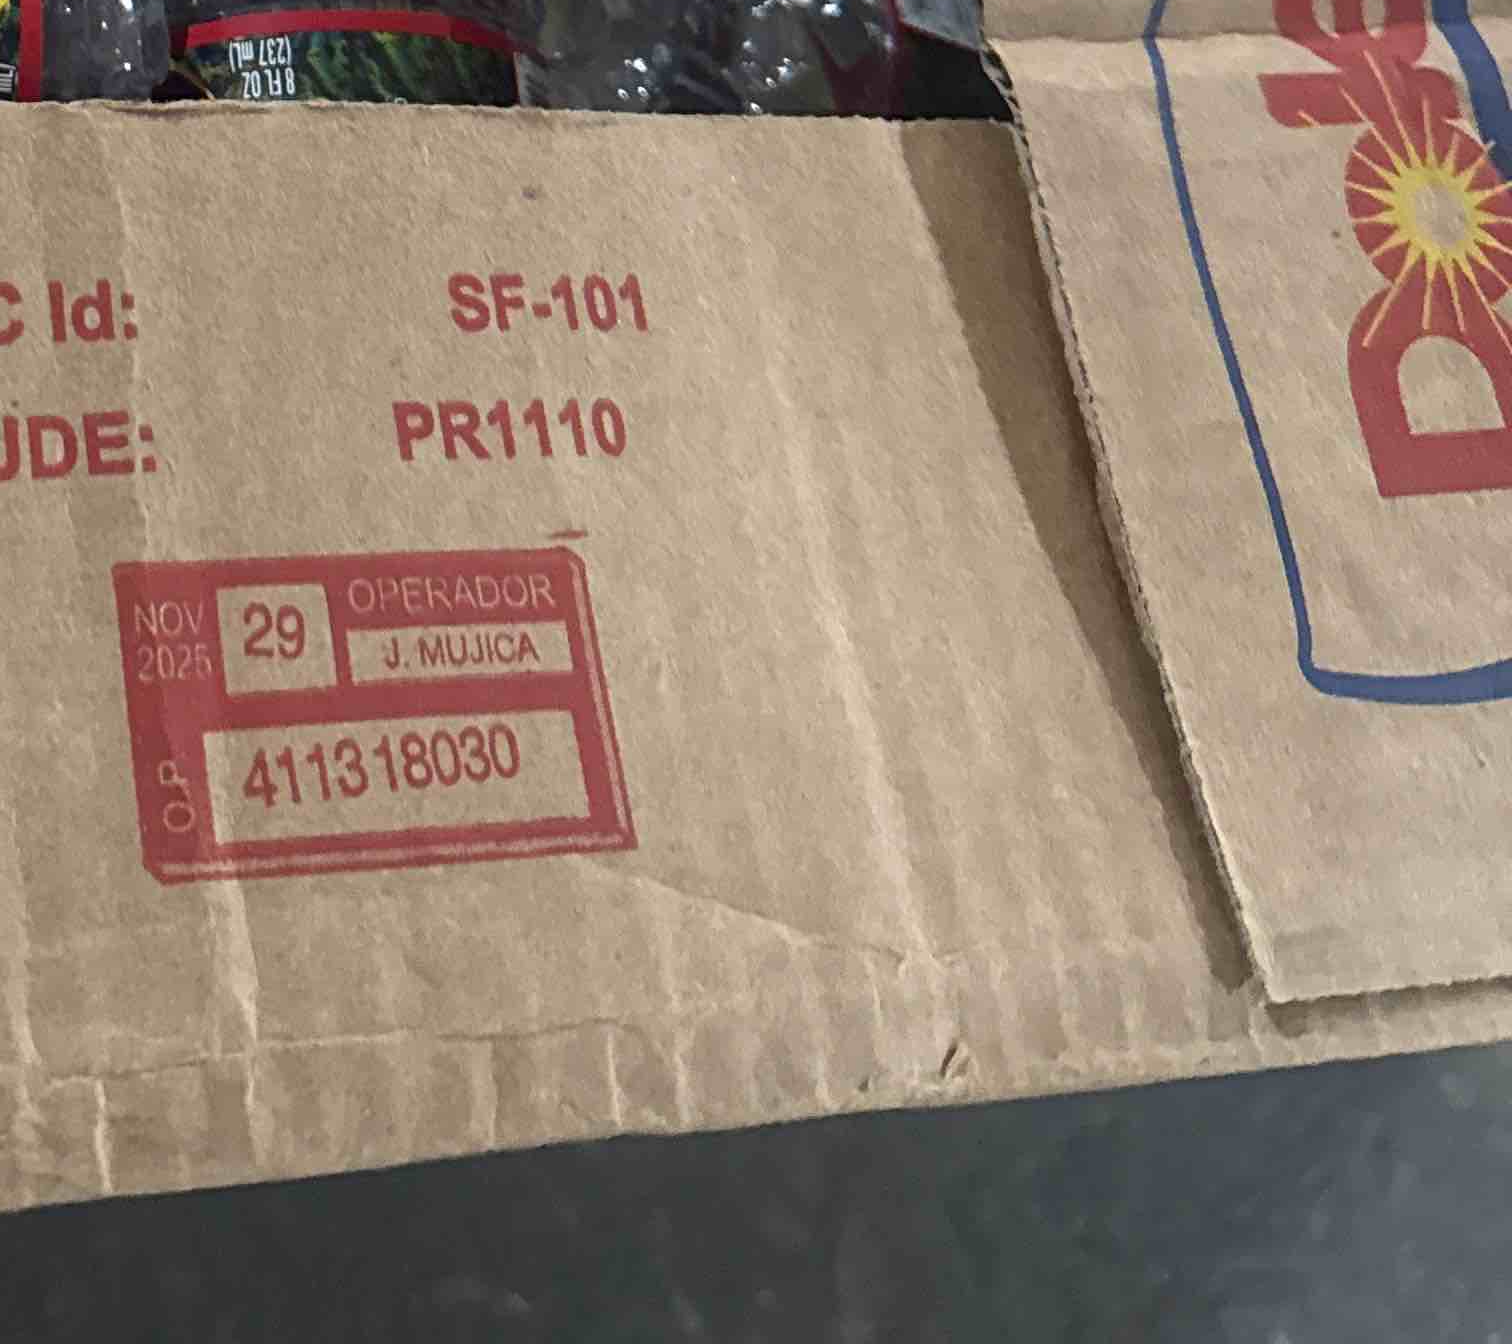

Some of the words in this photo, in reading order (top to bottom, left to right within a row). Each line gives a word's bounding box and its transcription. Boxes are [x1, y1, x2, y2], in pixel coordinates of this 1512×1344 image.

[228, 39, 254, 72] mL)
[259, 34, 292, 66] (237
[241, 69, 262, 98] OZ
[264, 68, 283, 97] FL
[285, 67, 296, 95] 8
[446, 272, 651, 334] SF-101
[391, 397, 628, 463] PR1110
[346, 574, 557, 614] OPERADOR
[133, 601, 205, 636] NOV
[241, 601, 306, 661] 29
[382, 640, 411, 671] J.
[419, 630, 540, 668] MUJICA
